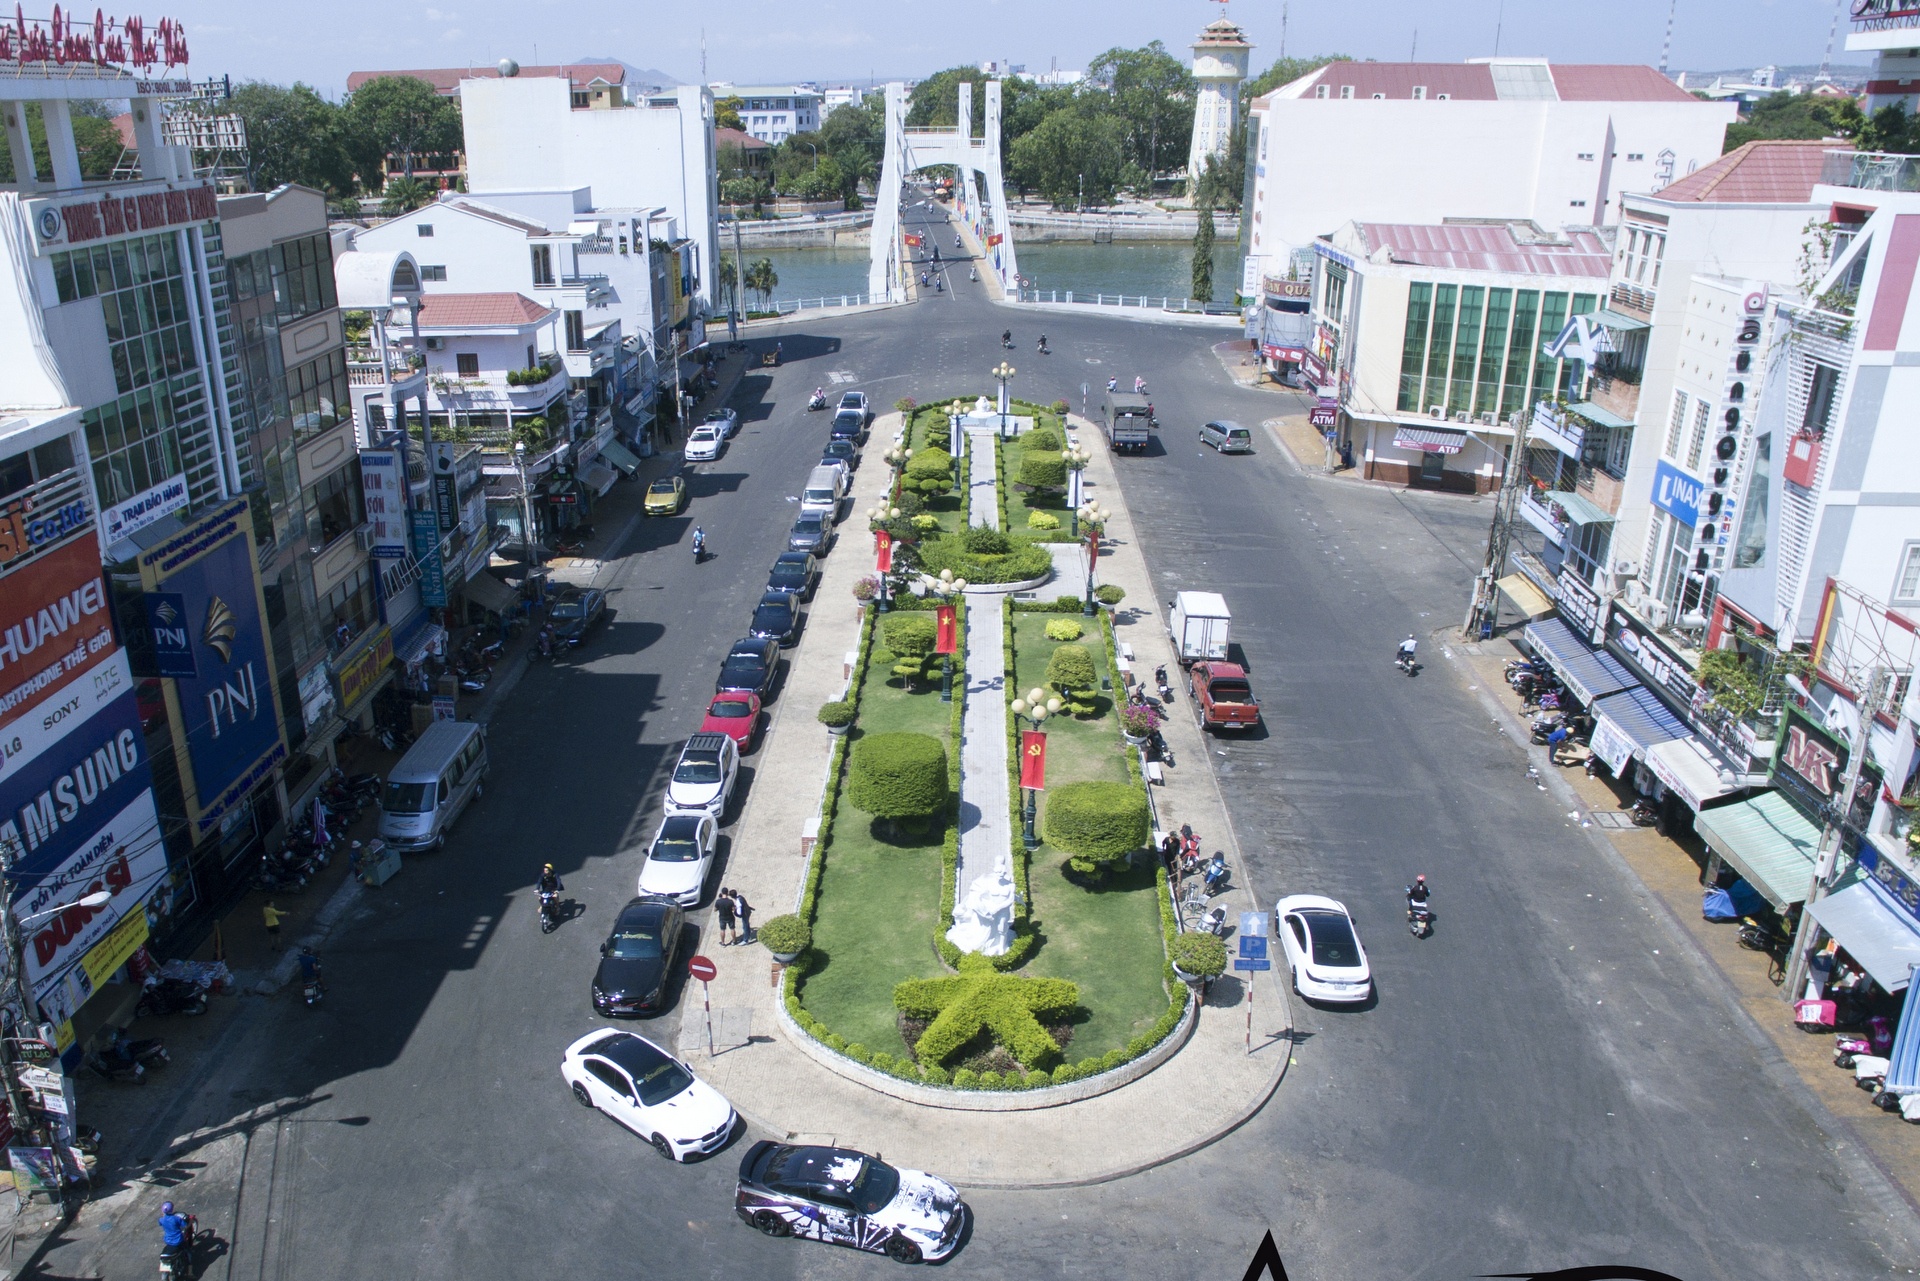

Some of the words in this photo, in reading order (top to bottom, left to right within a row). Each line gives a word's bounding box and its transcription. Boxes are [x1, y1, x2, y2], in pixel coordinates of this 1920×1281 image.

[1312, 415, 1335, 425] ATM
[1438, 445, 1459, 455] ATM
[146, 491, 163, 512] BẢO
[1671, 476, 1703, 510] INAX
[0, 577, 105, 671] HUAWEI
[155, 627, 187, 649] PNJ
[62, 638, 87, 670] THẾ
[88, 626, 112, 654] GIỚI
[43, 696, 80, 731] SONY
[205, 661, 259, 740] PNJ
[5, 737, 22, 758] LG
[31, 889, 50, 913] ĐỐI
[68, 852, 93, 880] TOÀN
[93, 832, 114, 859] DIỆN
[1246, 940, 1261, 951] P
